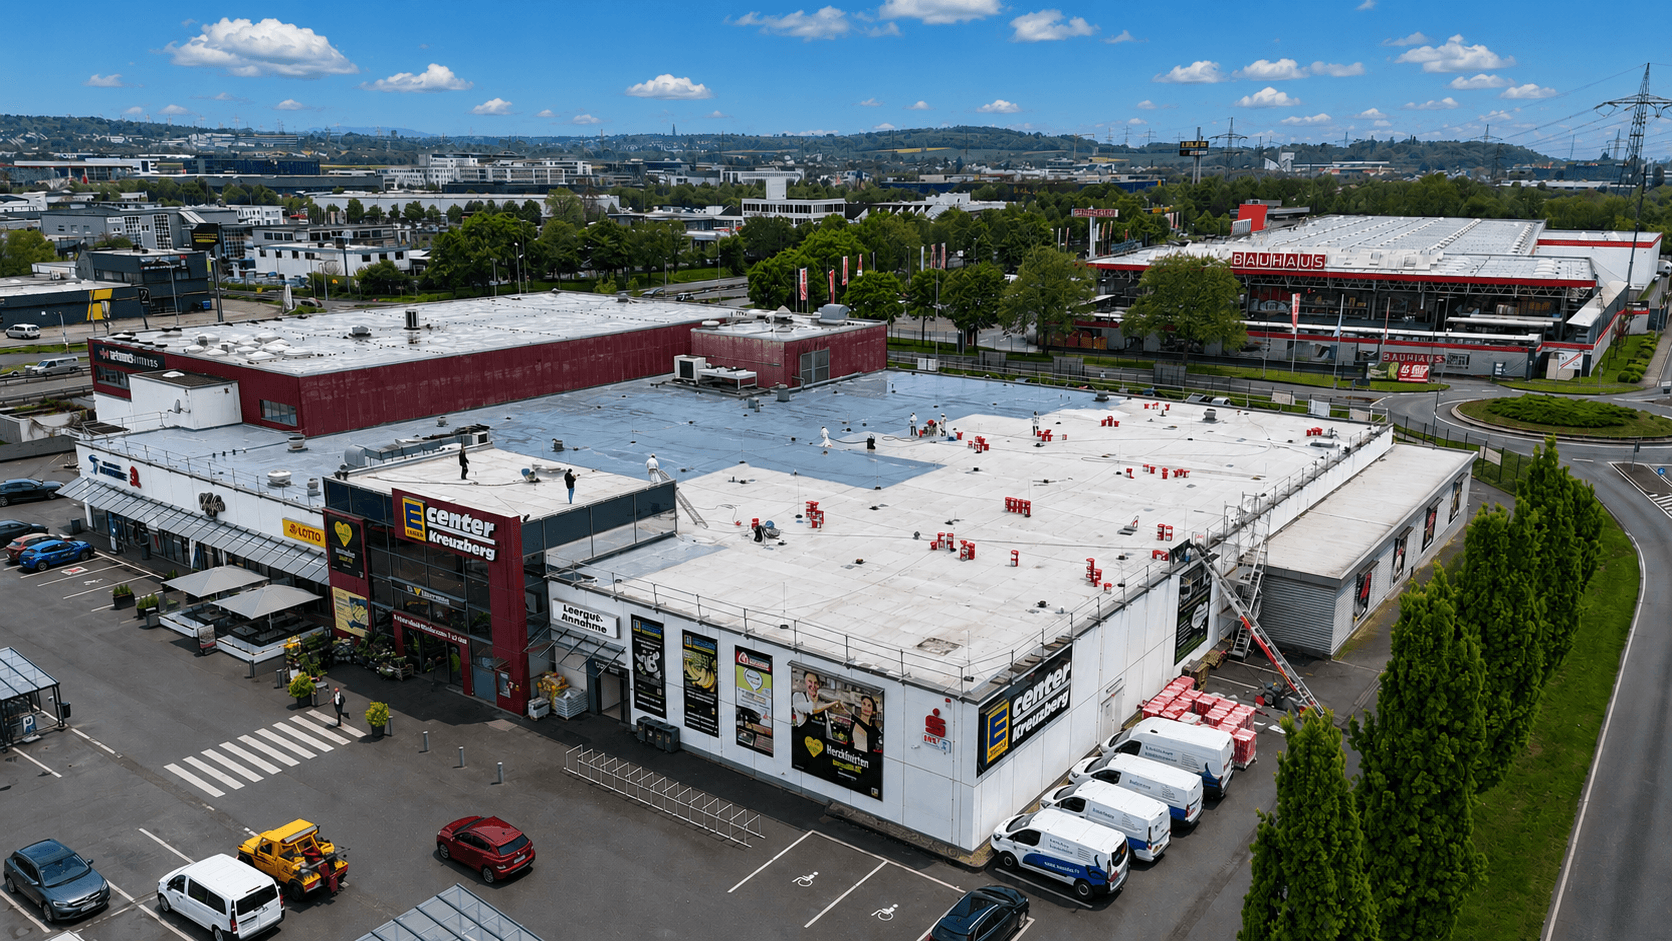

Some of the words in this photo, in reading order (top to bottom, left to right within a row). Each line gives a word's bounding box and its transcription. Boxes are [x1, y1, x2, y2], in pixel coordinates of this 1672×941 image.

[1233, 253, 1323, 268] BAUHAUS
[298, 527, 321, 542] LOTTO
[426, 506, 495, 538] center
[428, 529, 496, 561] Kreuzberg
[561, 613, 607, 634] Annahme
[1012, 661, 1071, 718] center
[23, 715, 34, 733] P
[1012, 690, 1069, 743] Kreuzberg
